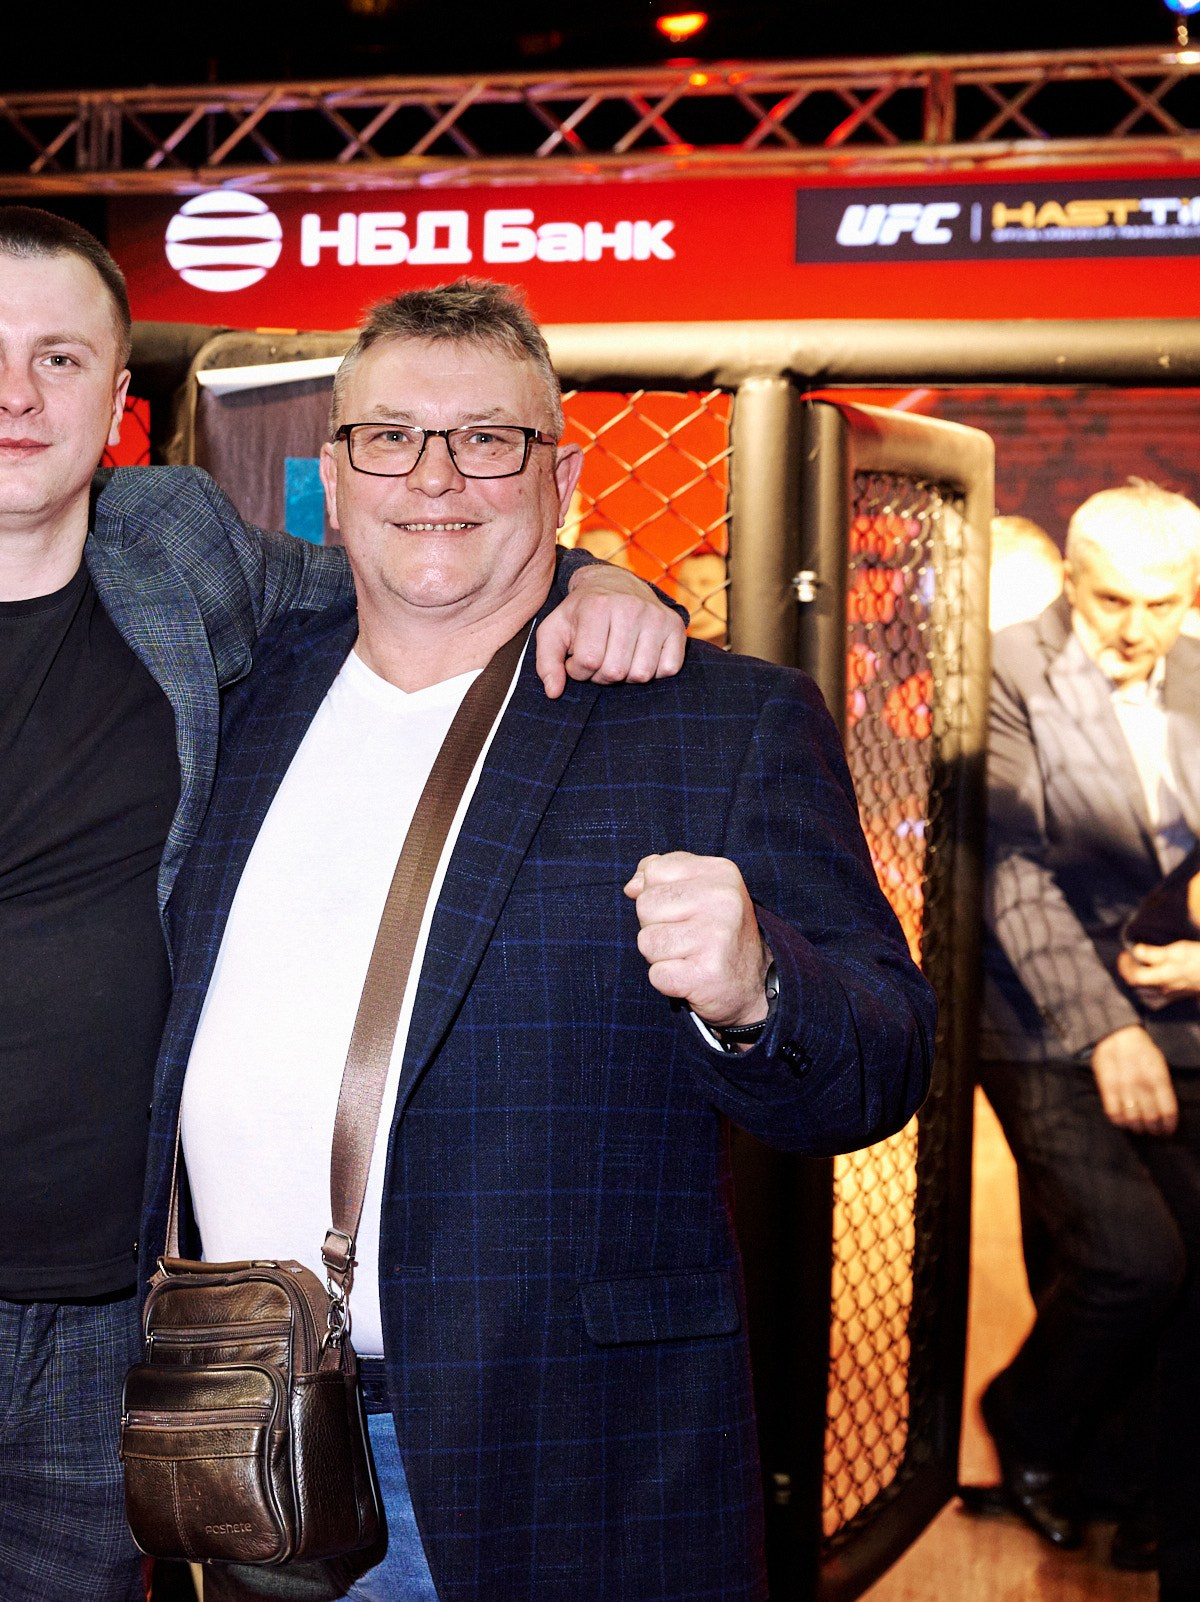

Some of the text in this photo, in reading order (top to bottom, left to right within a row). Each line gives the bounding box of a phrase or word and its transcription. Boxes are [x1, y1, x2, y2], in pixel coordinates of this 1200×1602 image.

[300, 208, 675, 267] НБД Банк
[836, 202, 961, 246] UFC
